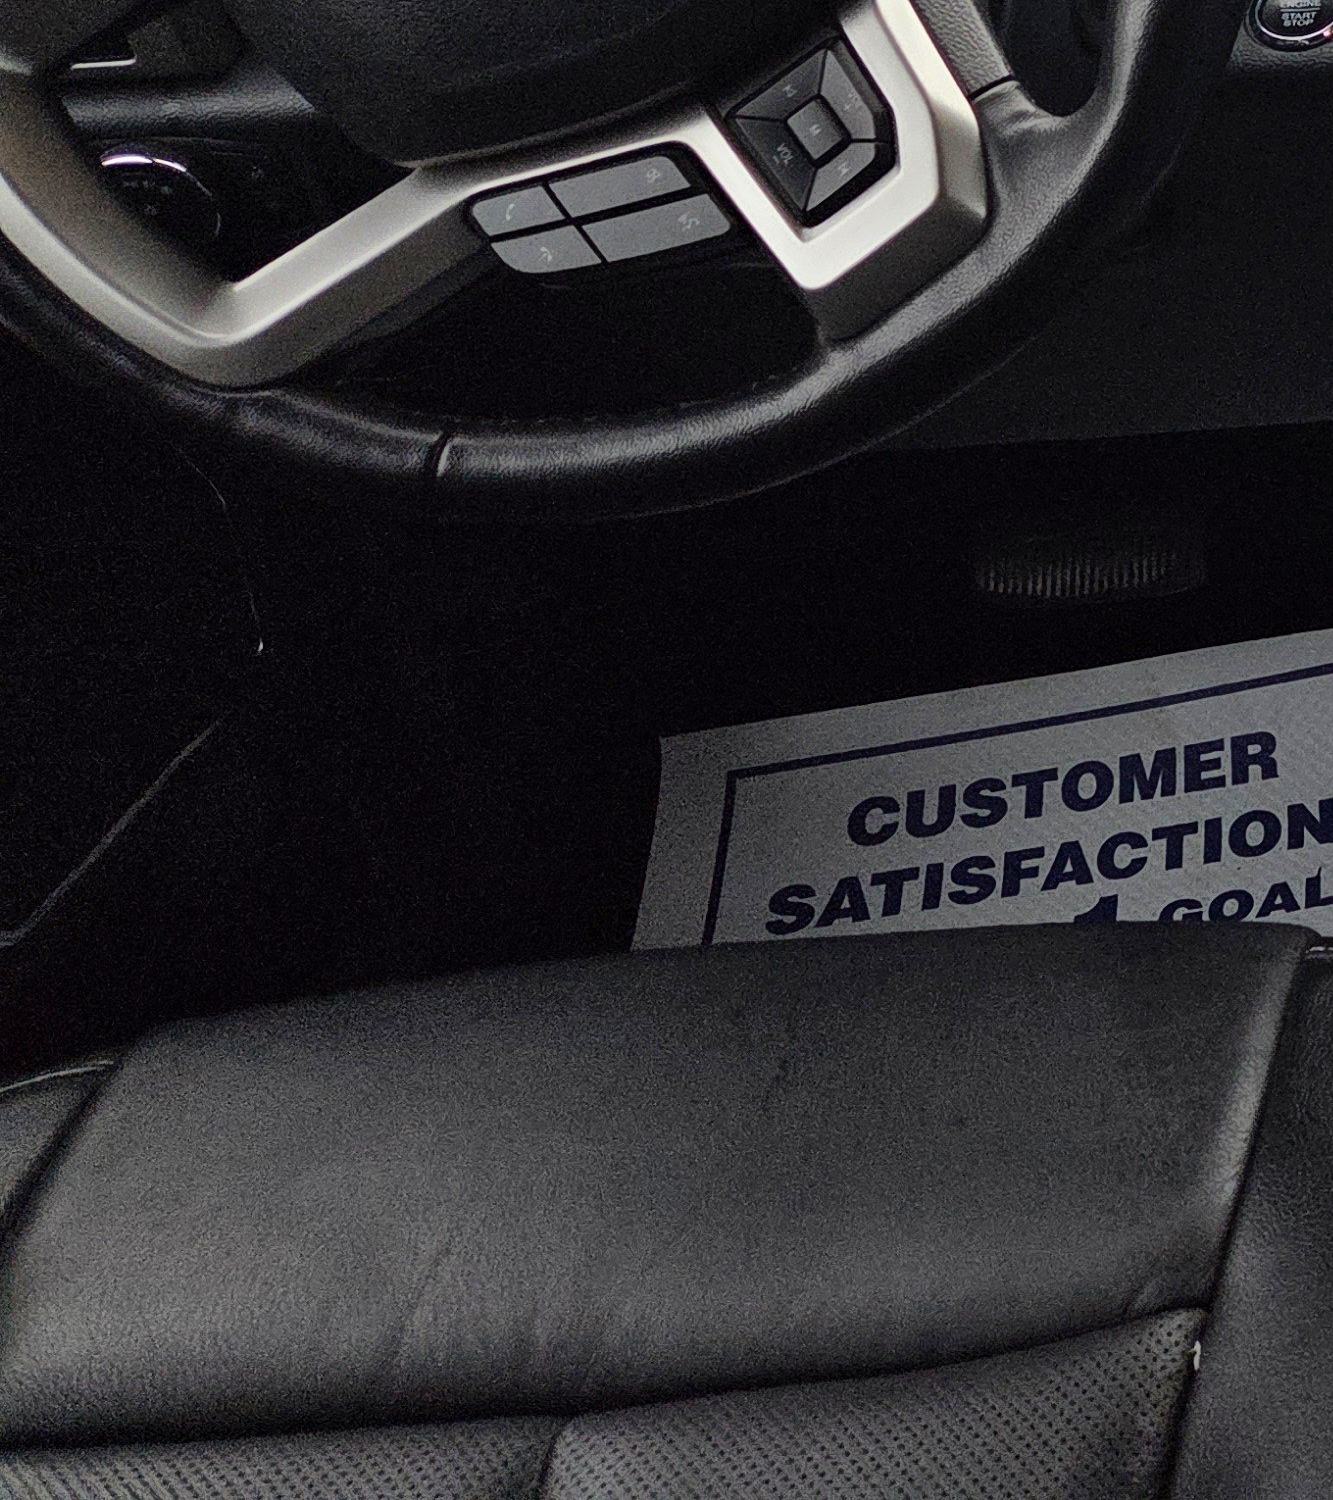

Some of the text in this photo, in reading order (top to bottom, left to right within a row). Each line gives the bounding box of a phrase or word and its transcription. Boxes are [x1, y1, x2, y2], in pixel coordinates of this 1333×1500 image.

[1281, 11, 1317, 20] START
[1283, 19, 1314, 27] STOP
[847, 730, 1280, 848] CUSTOMER
